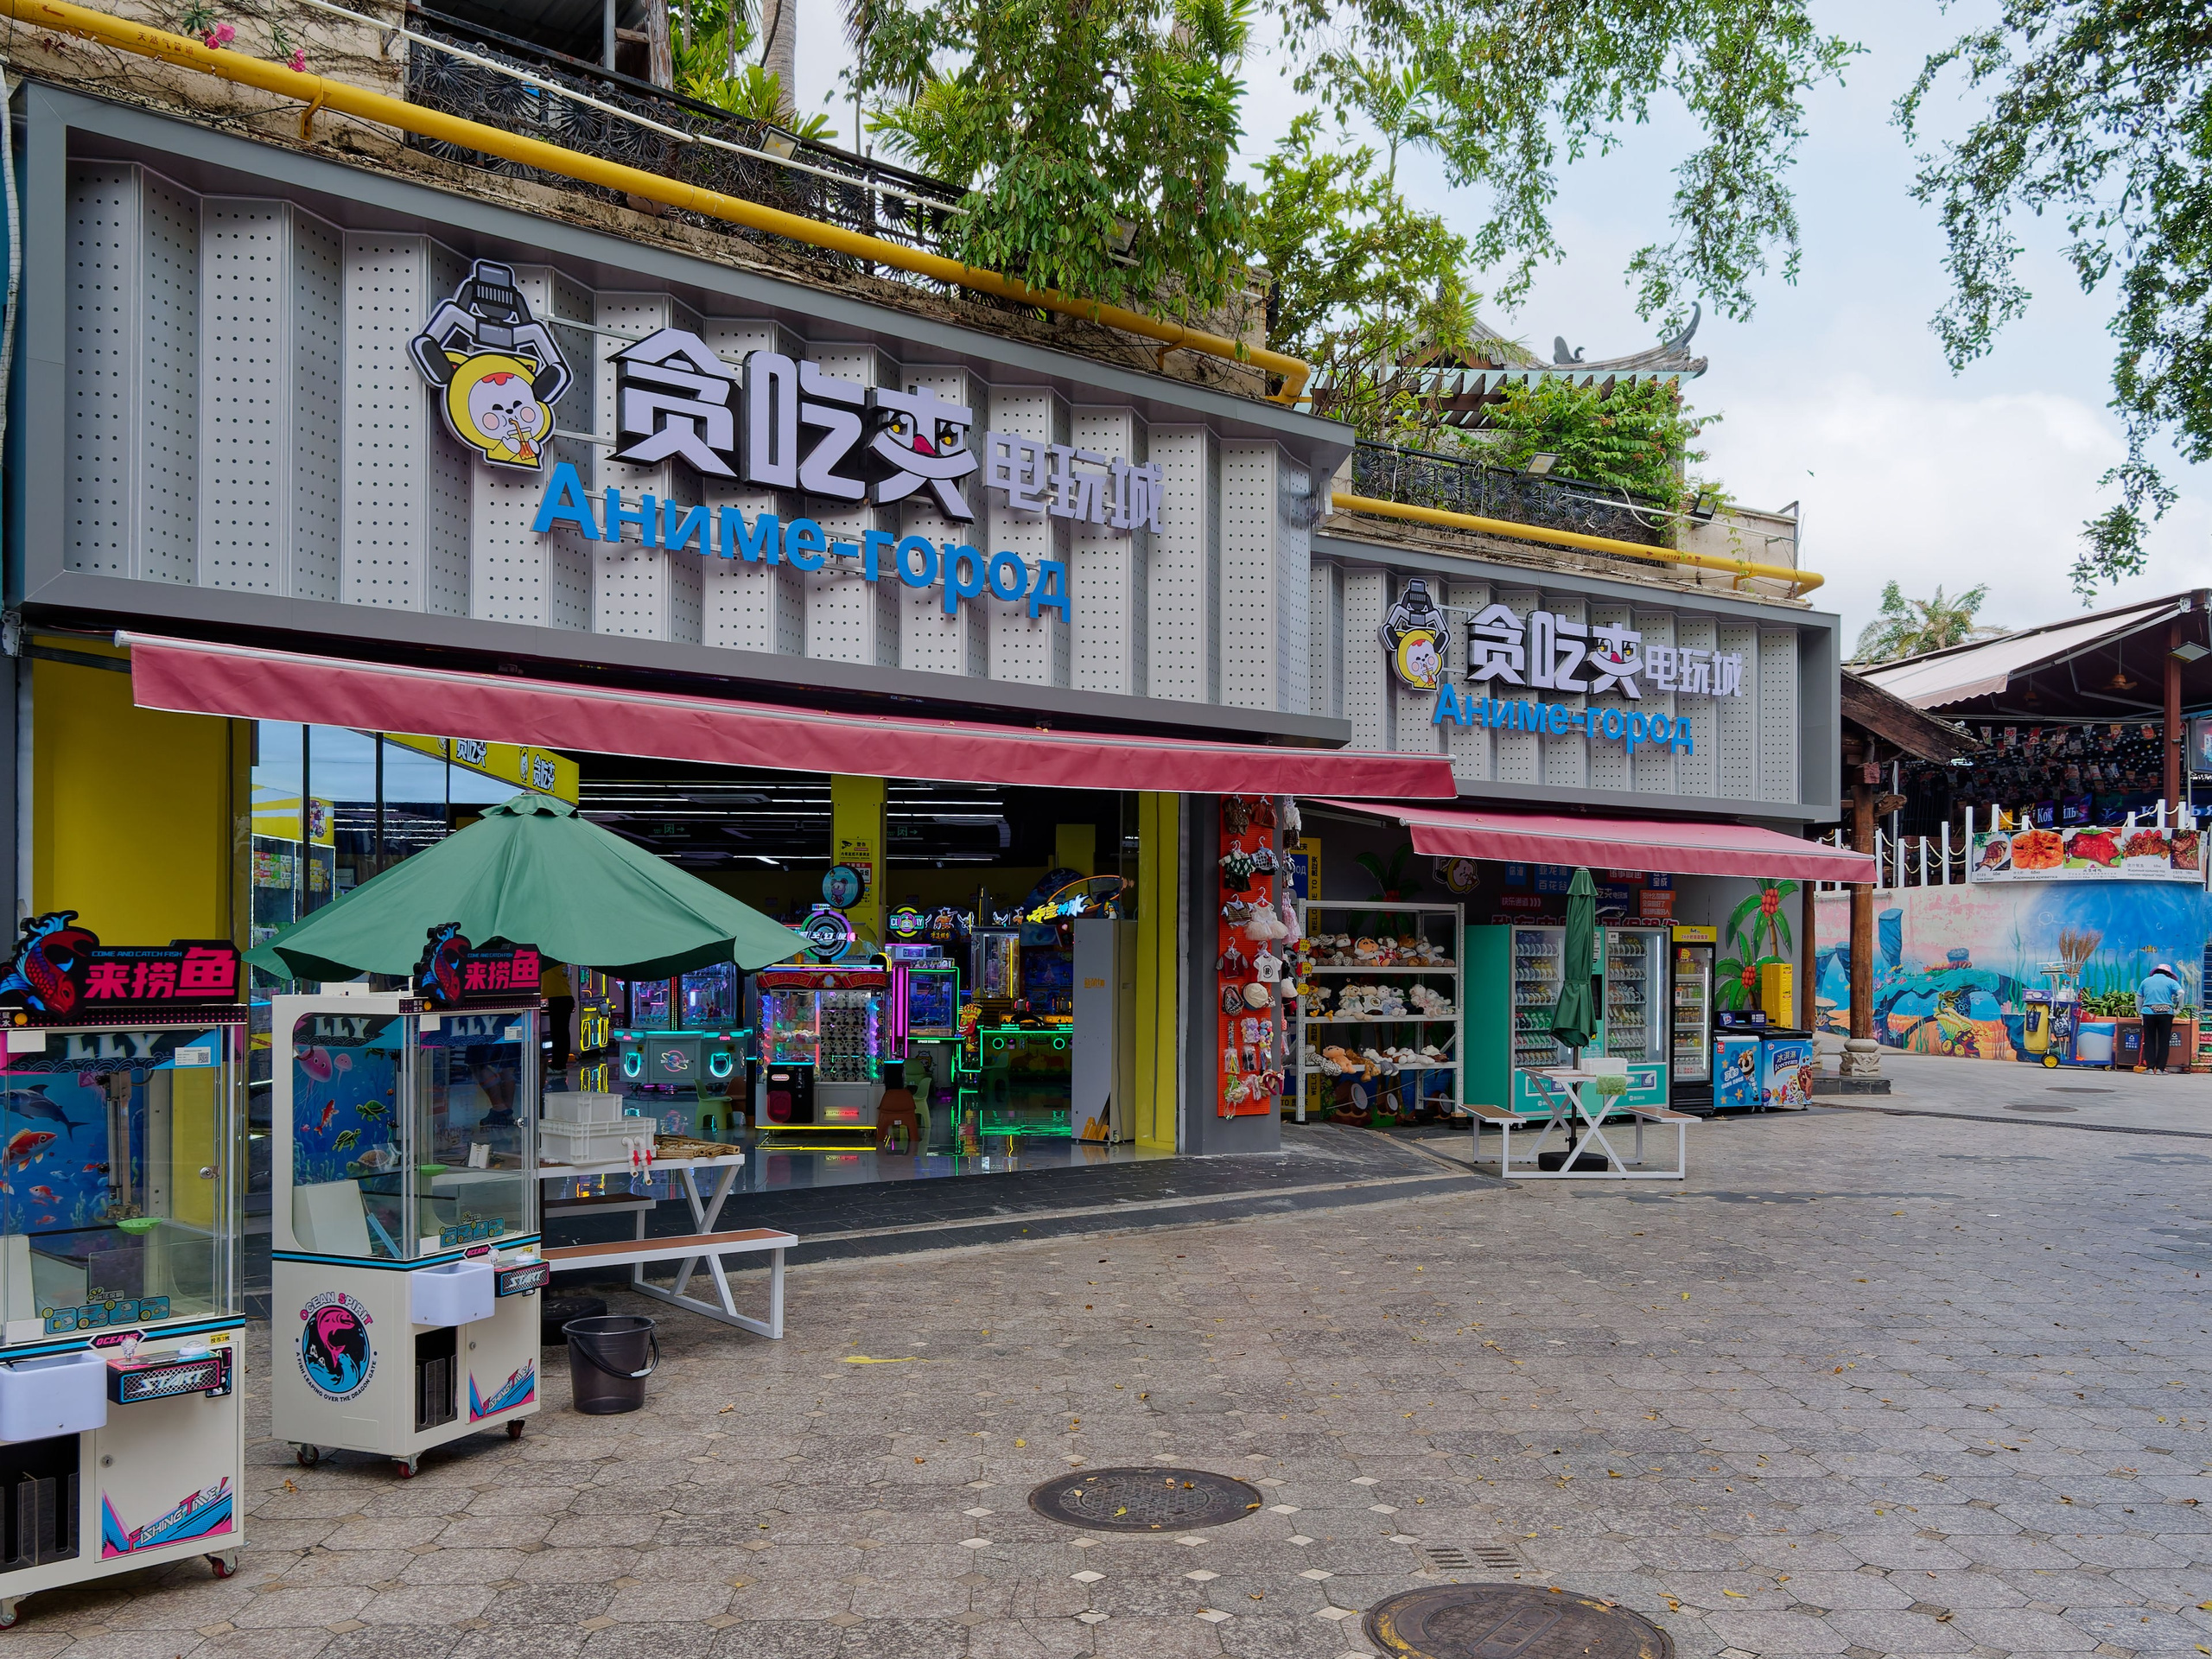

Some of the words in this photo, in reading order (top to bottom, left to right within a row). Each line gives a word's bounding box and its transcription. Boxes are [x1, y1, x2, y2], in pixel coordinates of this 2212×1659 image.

[531, 461, 1071, 624] Аниме-город
[1432, 683, 1693, 754] Аниме-город
[1538, 880, 1567, 891] 百花谷
[84, 946, 236, 999] 来捞鱼
[463, 949, 540, 990] 来捞鱼
[314, 1016, 372, 1038] LLY
[449, 1015, 500, 1036] LLY
[64, 1033, 164, 1059] LLY
[1777, 1051, 1797, 1064] 冰淇淋
[1775, 1059, 1798, 1071] Icecream
[467, 1246, 489, 1256] OCEANS
[300, 1292, 335, 1320] OCEAN
[338, 1293, 373, 1325] SPIRIT
[130, 1369, 213, 1394] START
[303, 1374, 323, 1396] LEAPING
[323, 1394, 339, 1402] OVER
[352, 1379, 370, 1399] DRAGON
